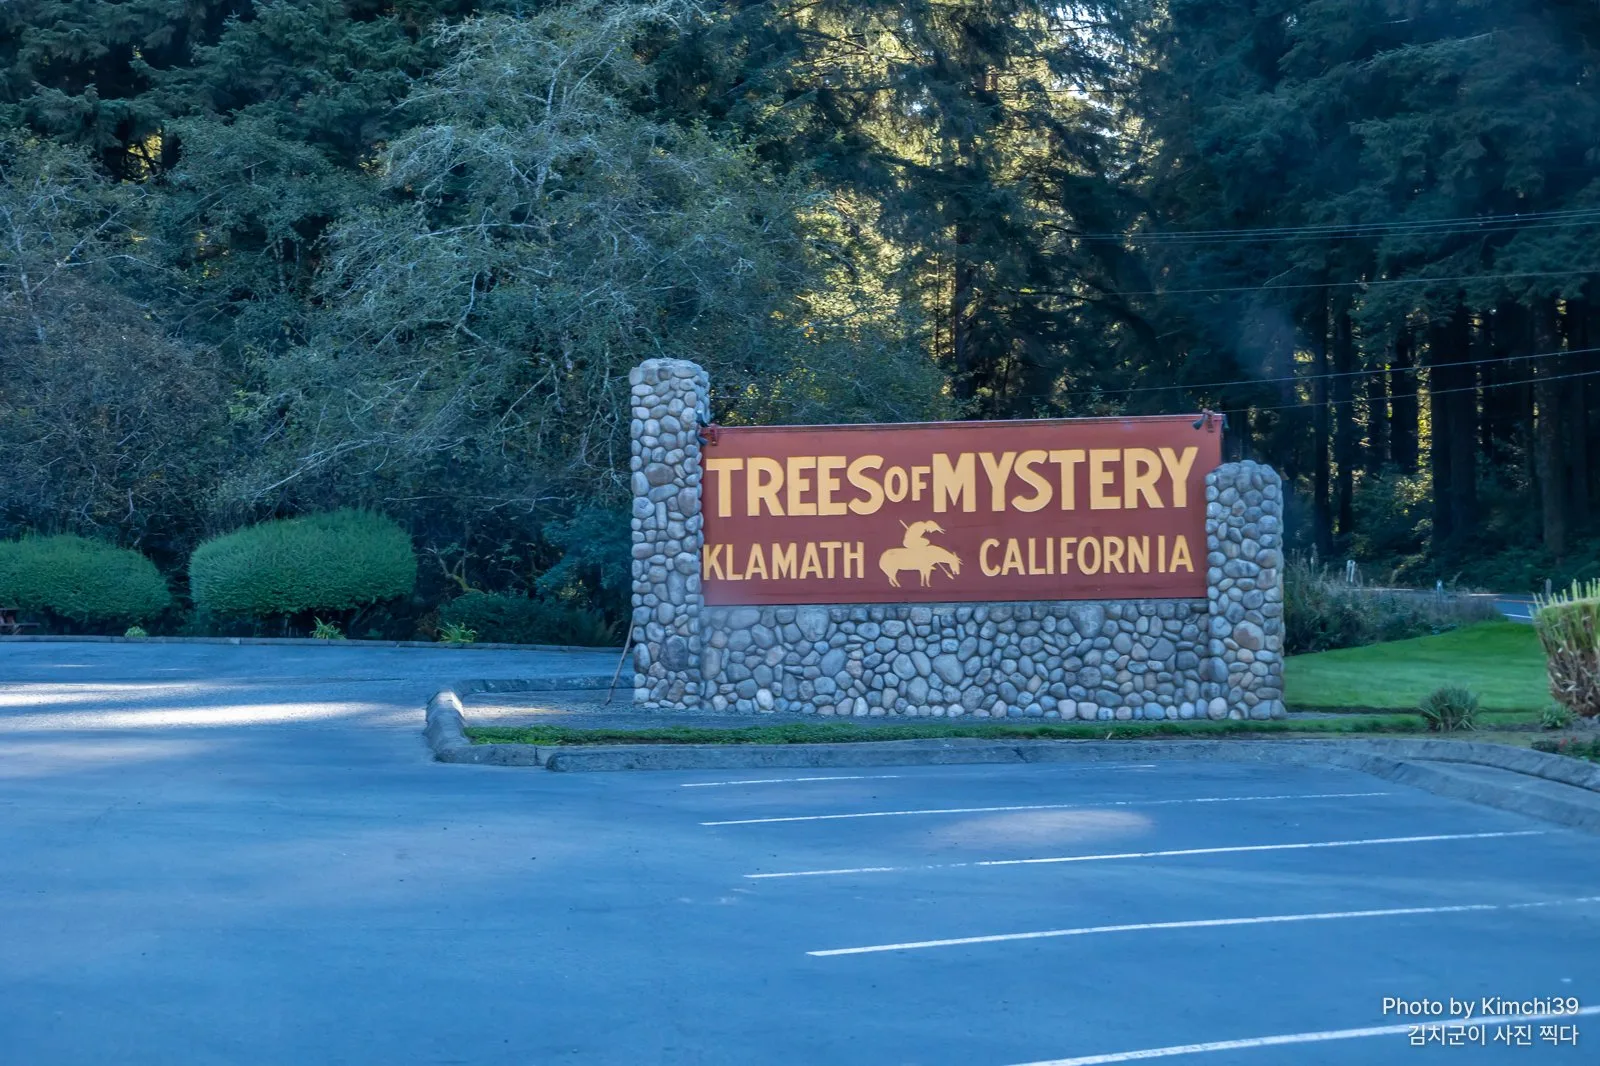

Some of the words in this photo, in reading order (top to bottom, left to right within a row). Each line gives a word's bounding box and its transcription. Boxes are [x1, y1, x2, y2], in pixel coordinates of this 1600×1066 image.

[706, 455, 885, 517] TREES
[884, 465, 931, 502] OF
[932, 447, 1199, 513] MYSTERY
[703, 541, 865, 581] KLAMATH
[979, 535, 1194, 576] CALIFORNIA
